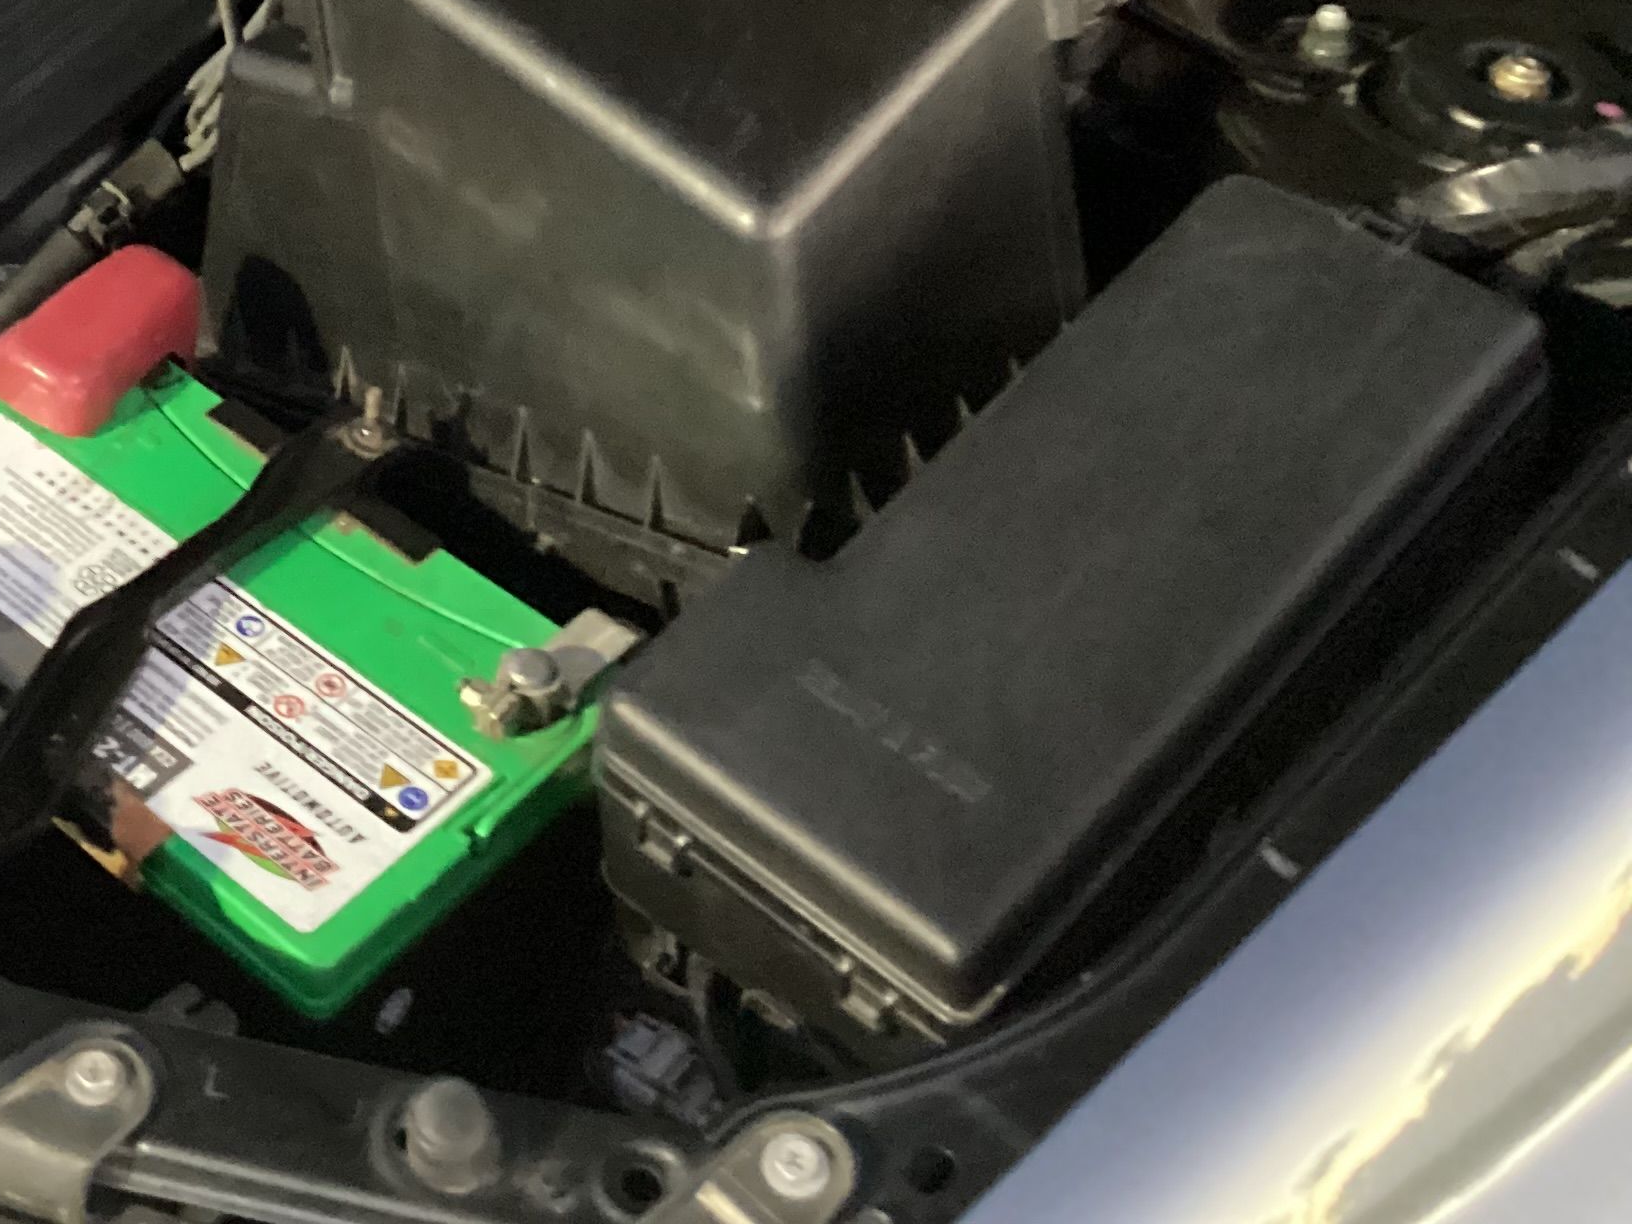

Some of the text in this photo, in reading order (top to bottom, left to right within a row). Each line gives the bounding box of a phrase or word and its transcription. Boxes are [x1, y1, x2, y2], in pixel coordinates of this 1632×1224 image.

[91, 734, 157, 790] MT-2
[253, 760, 366, 846] AUTOMOTIVE
[200, 794, 322, 889] INTERSTATE
[223, 790, 332, 874] BATTERIES
